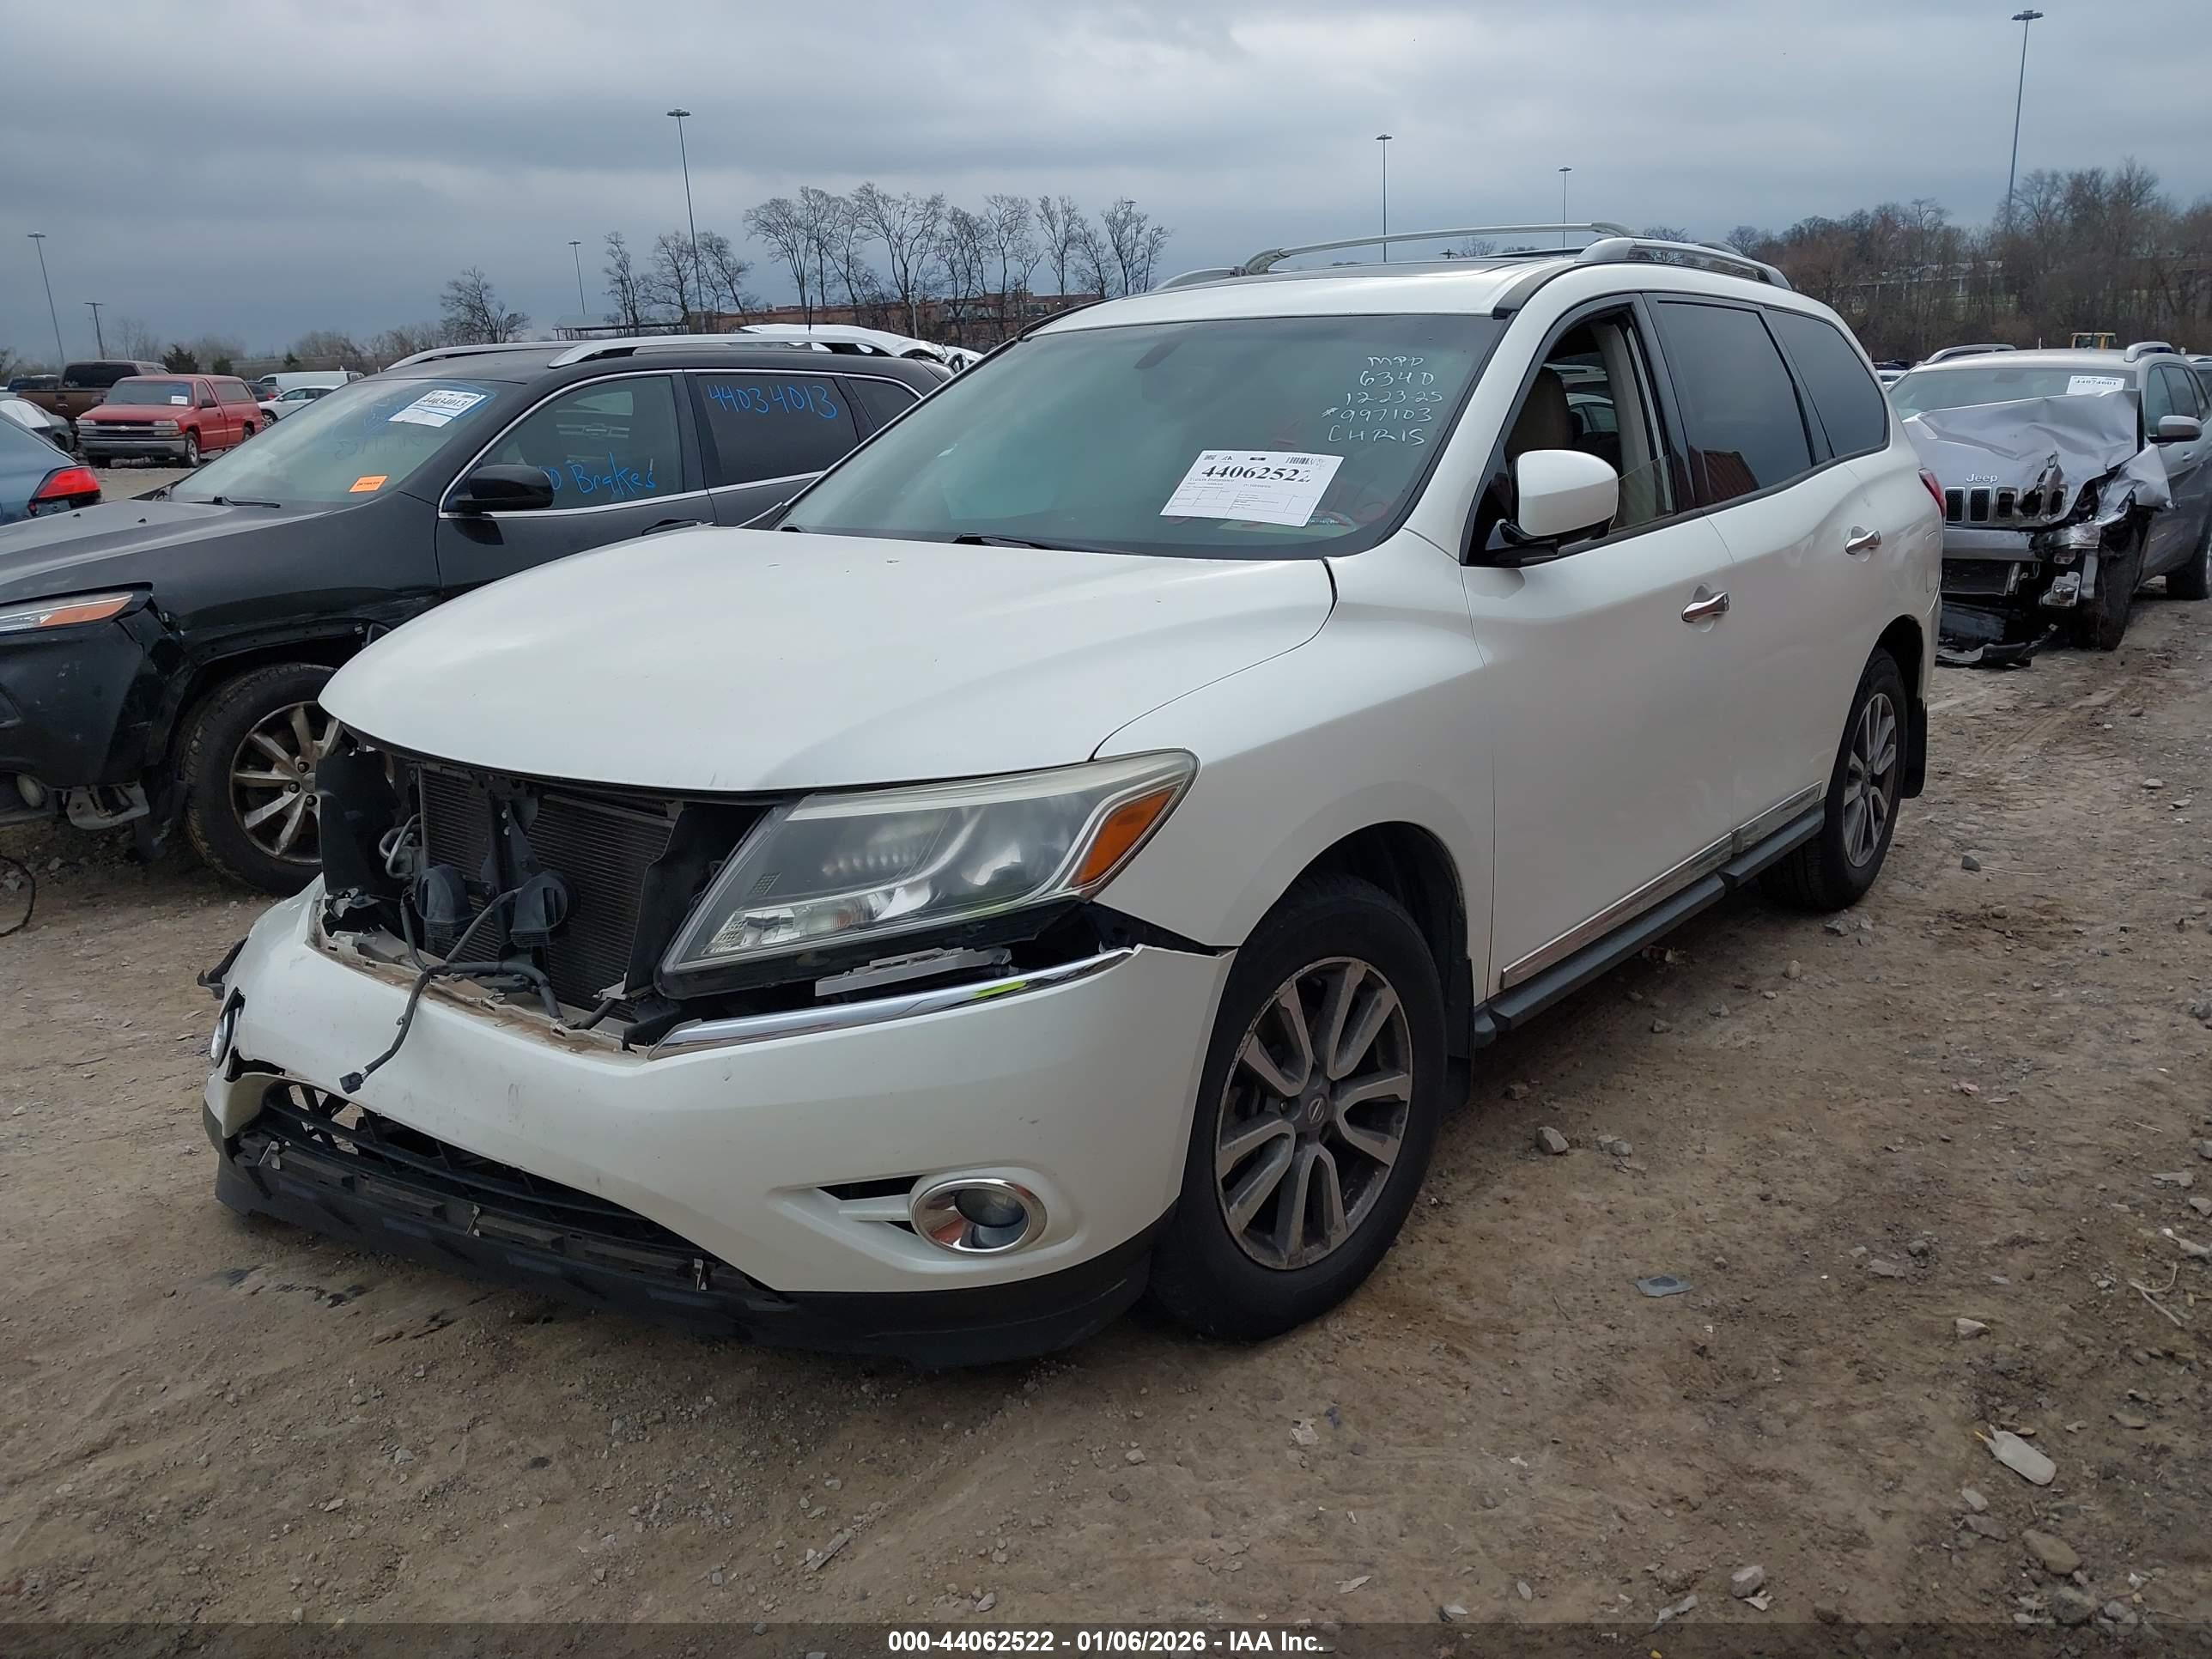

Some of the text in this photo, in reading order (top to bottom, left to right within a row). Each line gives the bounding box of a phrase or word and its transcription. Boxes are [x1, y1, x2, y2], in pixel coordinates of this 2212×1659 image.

[1367, 356, 1424, 368] MPD
[708, 383, 838, 419] 44034013
[1328, 424, 1425, 447] CHRIS
[570, 452, 658, 495] Brakes
[1201, 465, 1312, 483] 44062522
[1966, 472, 1998, 483] Jeep
